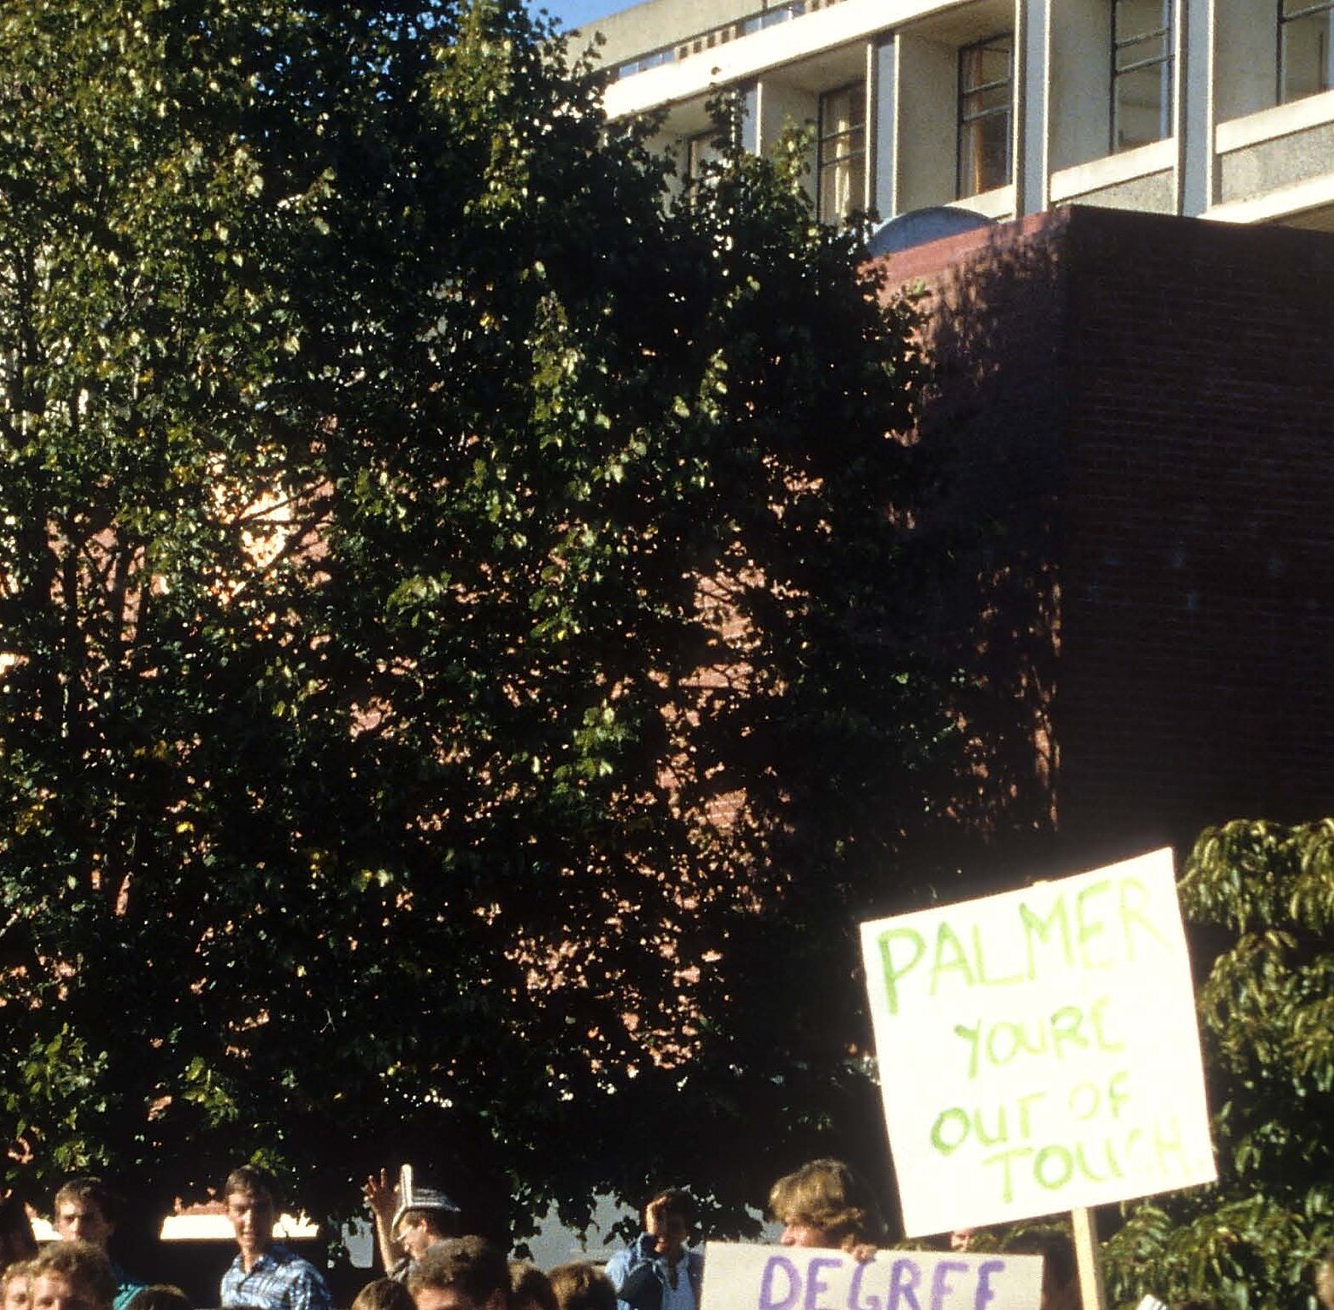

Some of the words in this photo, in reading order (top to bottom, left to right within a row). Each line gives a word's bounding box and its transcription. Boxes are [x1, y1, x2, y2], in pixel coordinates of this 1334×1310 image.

[877, 876, 1171, 1014] PALMER
[930, 1092, 1047, 1156] OUT
[1067, 1070, 1130, 1122] OF
